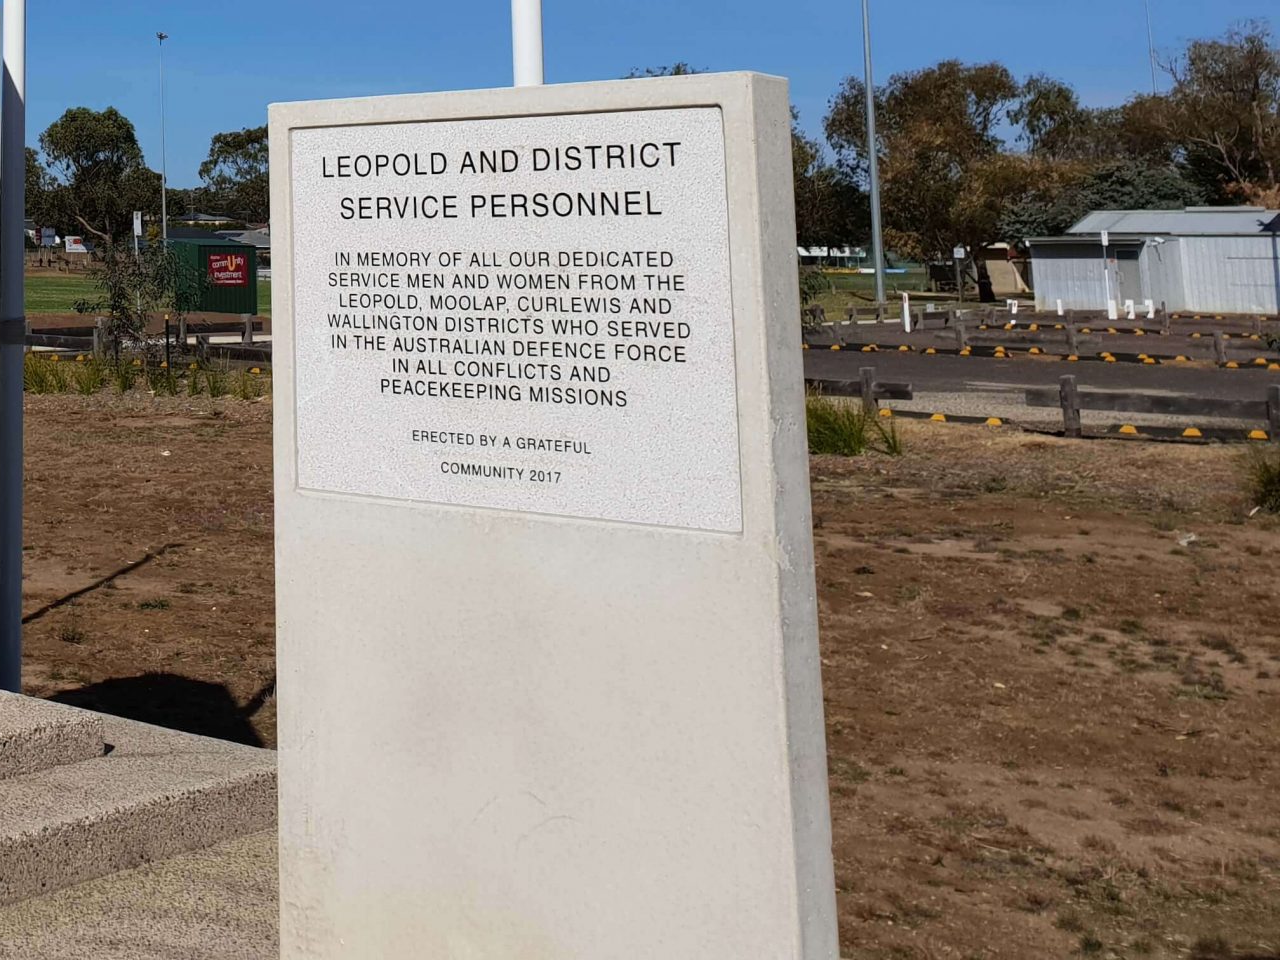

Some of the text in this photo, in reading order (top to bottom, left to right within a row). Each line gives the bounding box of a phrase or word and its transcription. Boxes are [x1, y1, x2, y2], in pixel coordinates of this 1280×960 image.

[322, 142, 681, 178] LEOPOLD AND DISTRICT
[339, 191, 662, 219] SERVICE PERSONNEL
[334, 251, 674, 268] IN MEMORY OF ALL OUR DEDICATED
[328, 273, 685, 292] SERVICE MEN AND WOMEN FROM THE
[339, 294, 672, 314] LEOPOLD, MOOLAP, CURLEWIS AND
[327, 314, 691, 339] WALLINGTON DISTRICTS WHO SERVED
[331, 335, 686, 363] IN THE AUSTRALIAN DEFENCE FORCE
[392, 359, 611, 382] IN ALL CONFLICTS AND
[380, 379, 628, 407] PEACEKEEPING MISSIONS
[412, 430, 592, 455] ERECTED BY A GRATEFUL
[440, 461, 562, 484] COMMUNITY 2017
